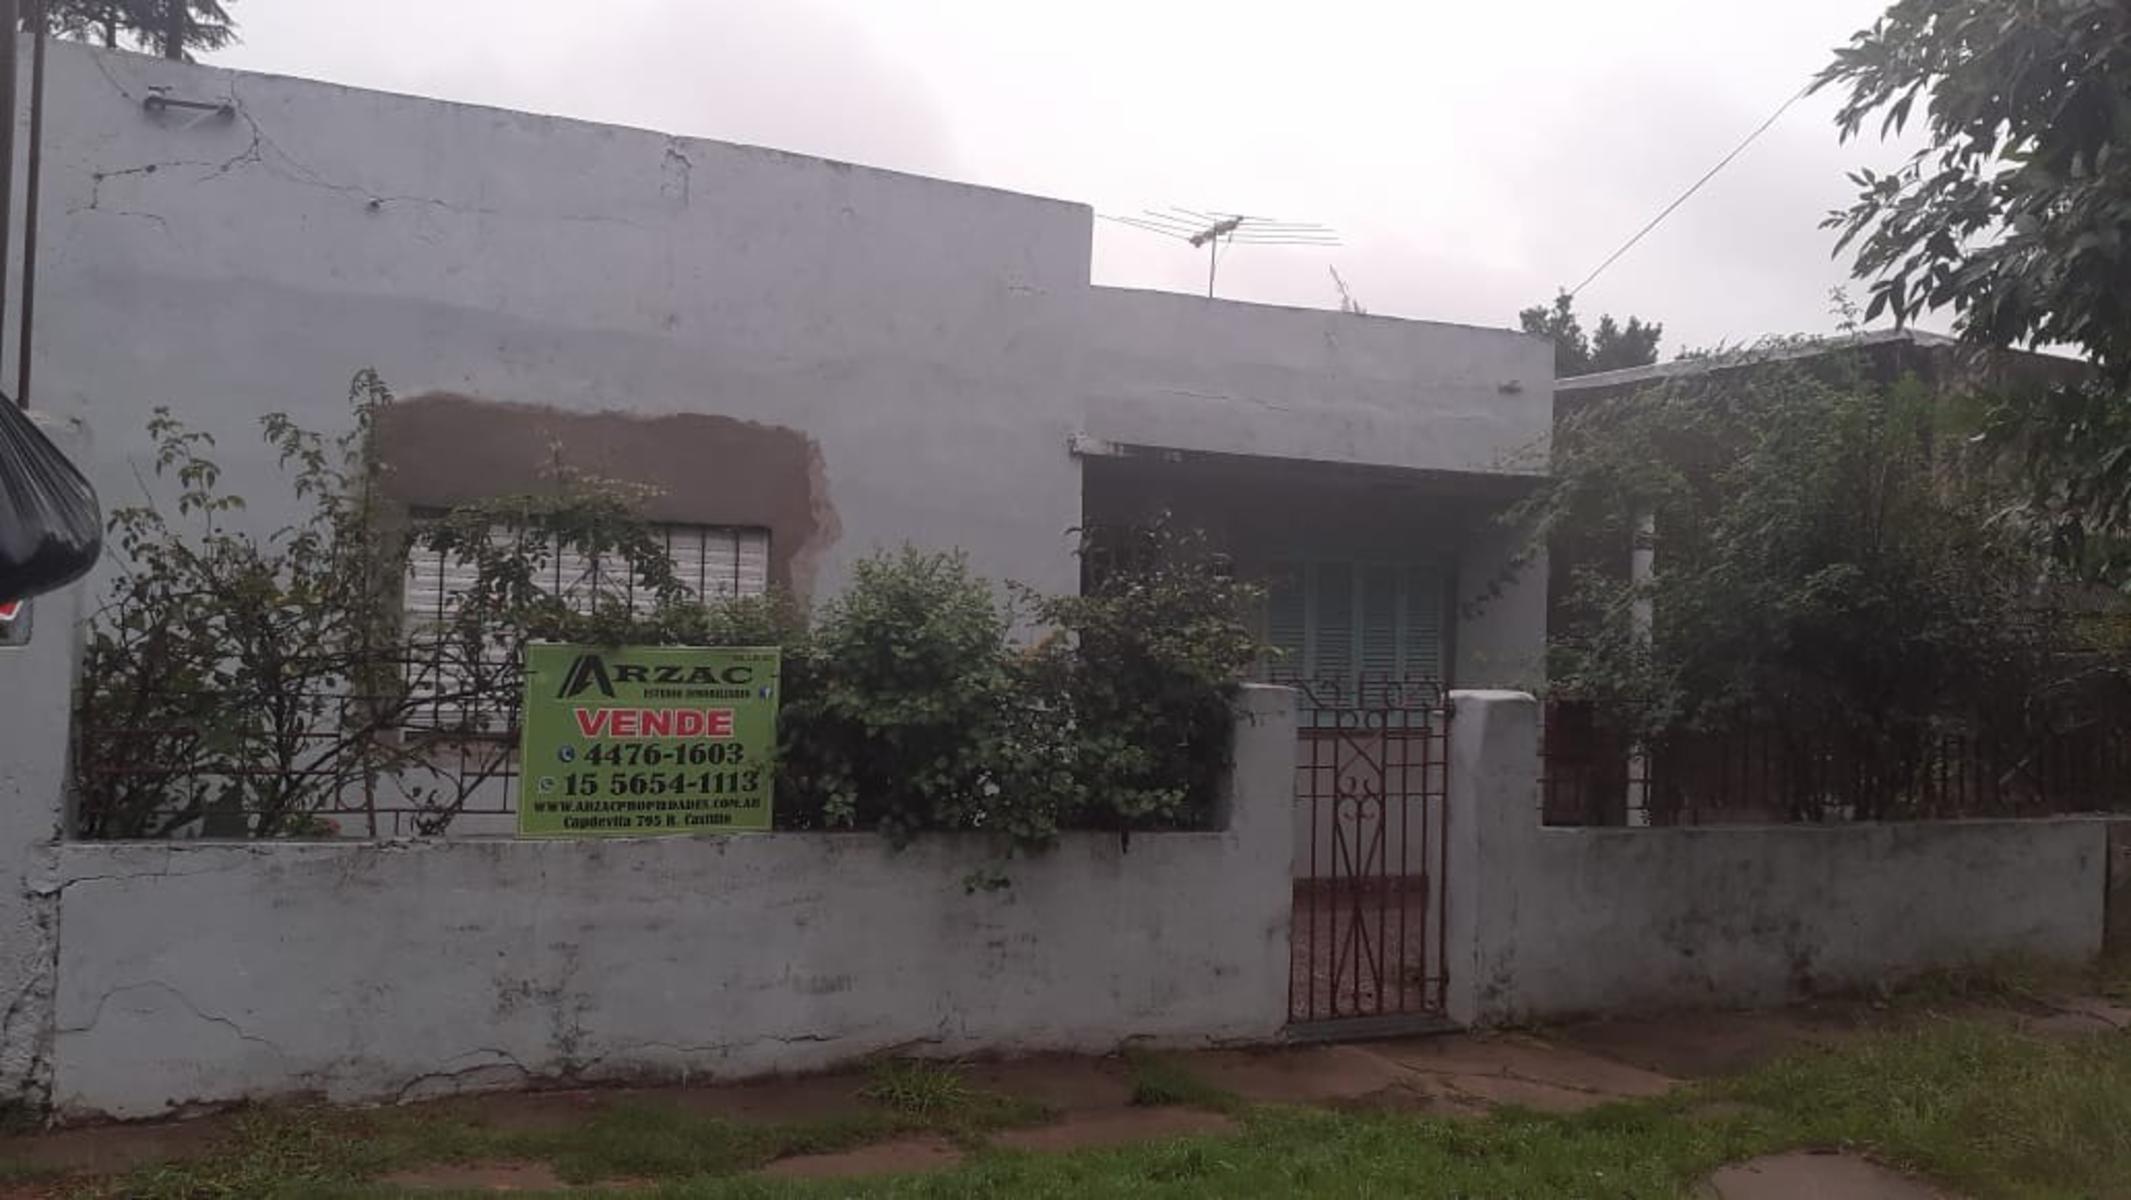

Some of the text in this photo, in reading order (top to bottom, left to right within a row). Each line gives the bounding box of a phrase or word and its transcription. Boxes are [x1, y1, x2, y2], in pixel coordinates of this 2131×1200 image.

[557, 654, 752, 699] ARZAC
[575, 707, 734, 738] VENDE
[583, 742, 744, 766] 4476-1603
[564, 770, 758, 796] 15 5654-1113
[636, 814, 662, 828] 795
